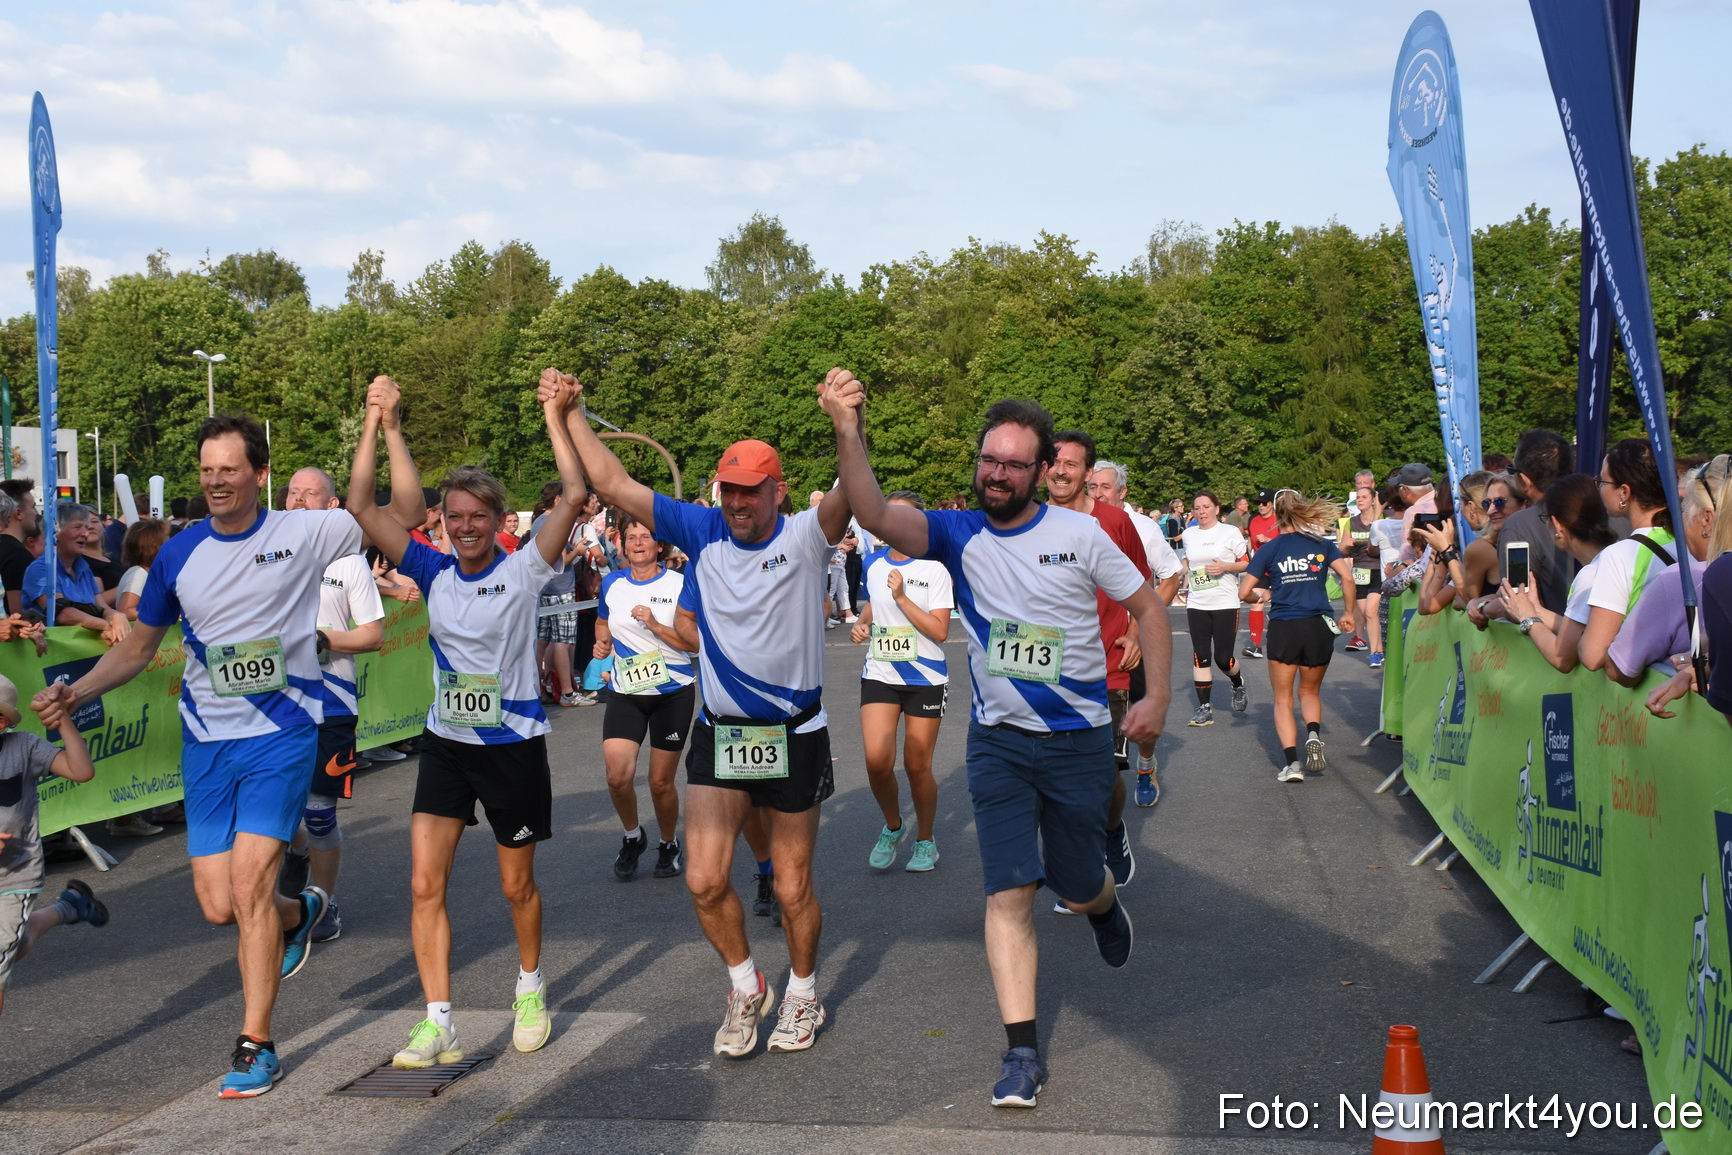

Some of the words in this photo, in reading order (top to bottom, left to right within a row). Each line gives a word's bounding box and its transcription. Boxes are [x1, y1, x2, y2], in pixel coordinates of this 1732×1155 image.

[1277, 556, 1309, 574] vhs
[1194, 575, 1211, 586] 654
[145, 635, 187, 673] Gesund
[877, 638, 911, 652] 1104
[997, 640, 1051, 666] 1113
[218, 658, 275, 683] 1099
[626, 663, 661, 683] 1112
[444, 690, 491, 712] 1100
[1548, 729, 1570, 750] Fischer
[725, 745, 778, 765] 1103
[108, 764, 184, 803] www.firmenlauf
[1537, 794, 1603, 875] firmenlauf
[1537, 865, 1565, 892] neumarkt
[1706, 1082, 1732, 1132] neuma
